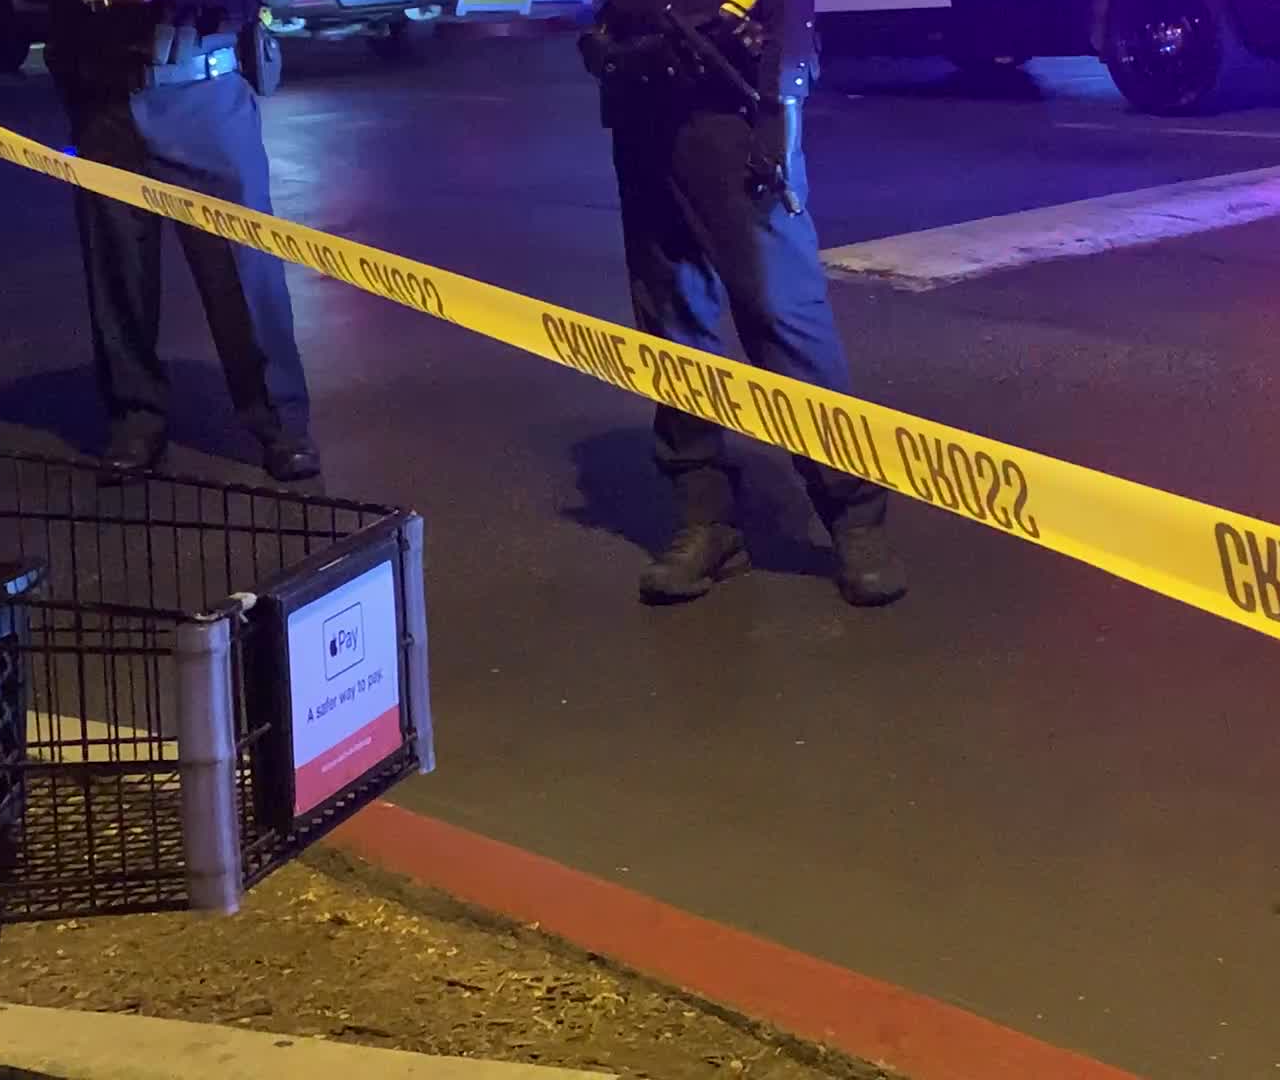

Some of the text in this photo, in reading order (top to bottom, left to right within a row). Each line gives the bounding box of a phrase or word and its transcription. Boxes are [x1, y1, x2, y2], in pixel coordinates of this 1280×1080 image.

[338, 626, 359, 654] Pay
[306, 706, 315, 724] A
[316, 696, 337, 719] safer
[339, 685, 356, 705] way
[358, 679, 366, 693] to
